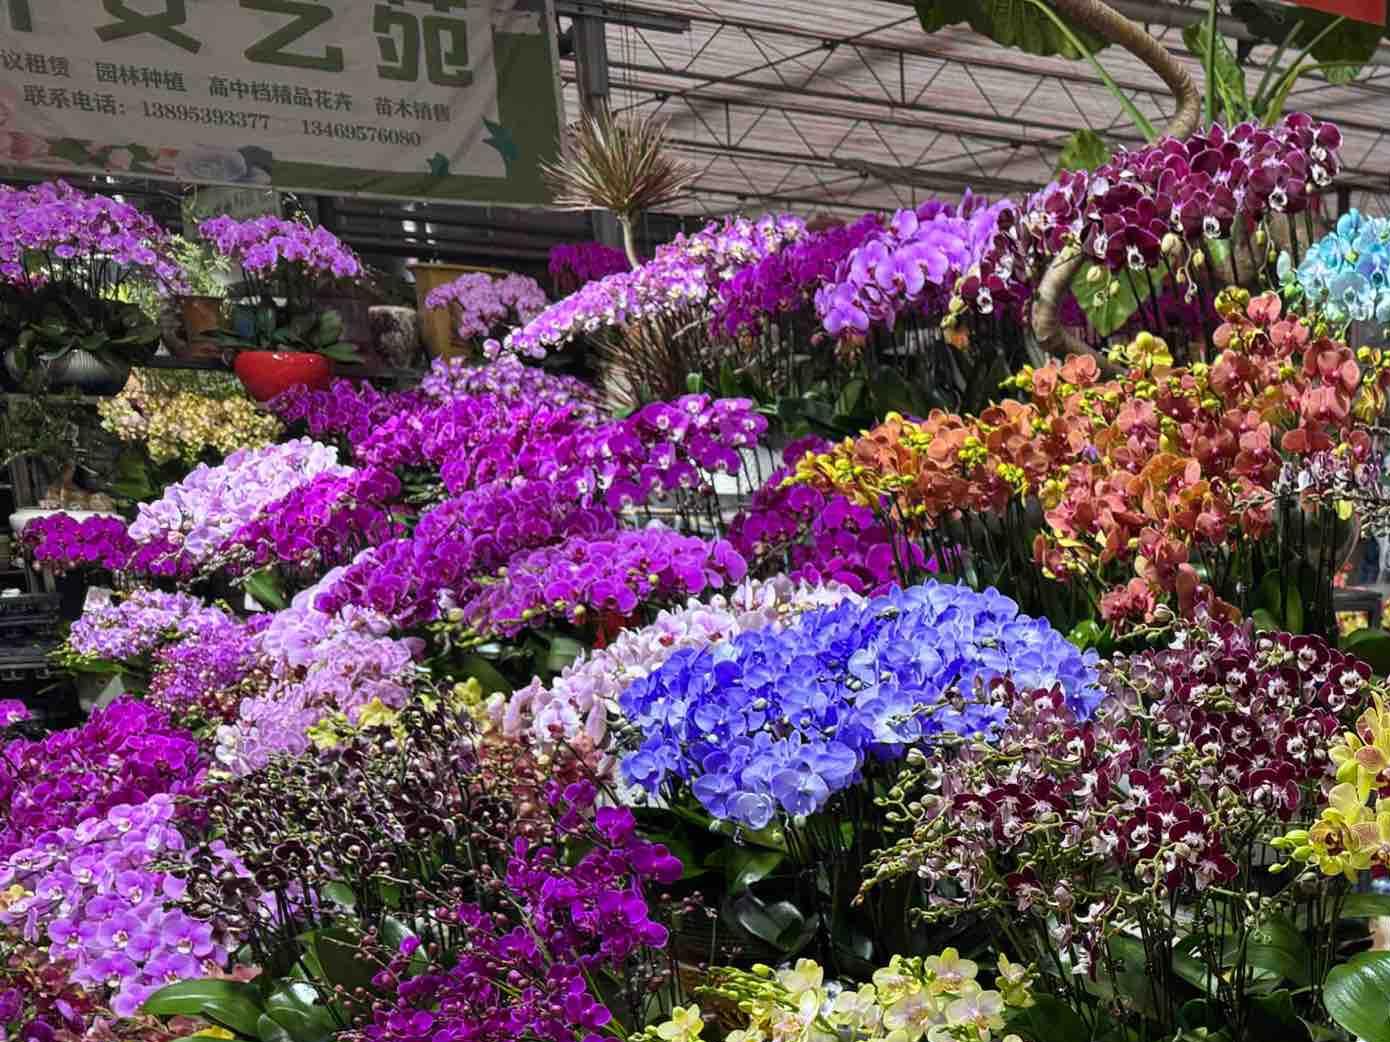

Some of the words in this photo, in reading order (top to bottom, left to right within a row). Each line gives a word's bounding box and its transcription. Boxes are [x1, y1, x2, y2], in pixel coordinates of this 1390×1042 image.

[96, 62, 186, 92] 园林种植
[208, 76, 353, 111] 高中档精品花卉
[374, 97, 451, 122] 苗木销售
[142, 100, 270, 130] 13895393377
[302, 119, 422, 146] 13469576080
